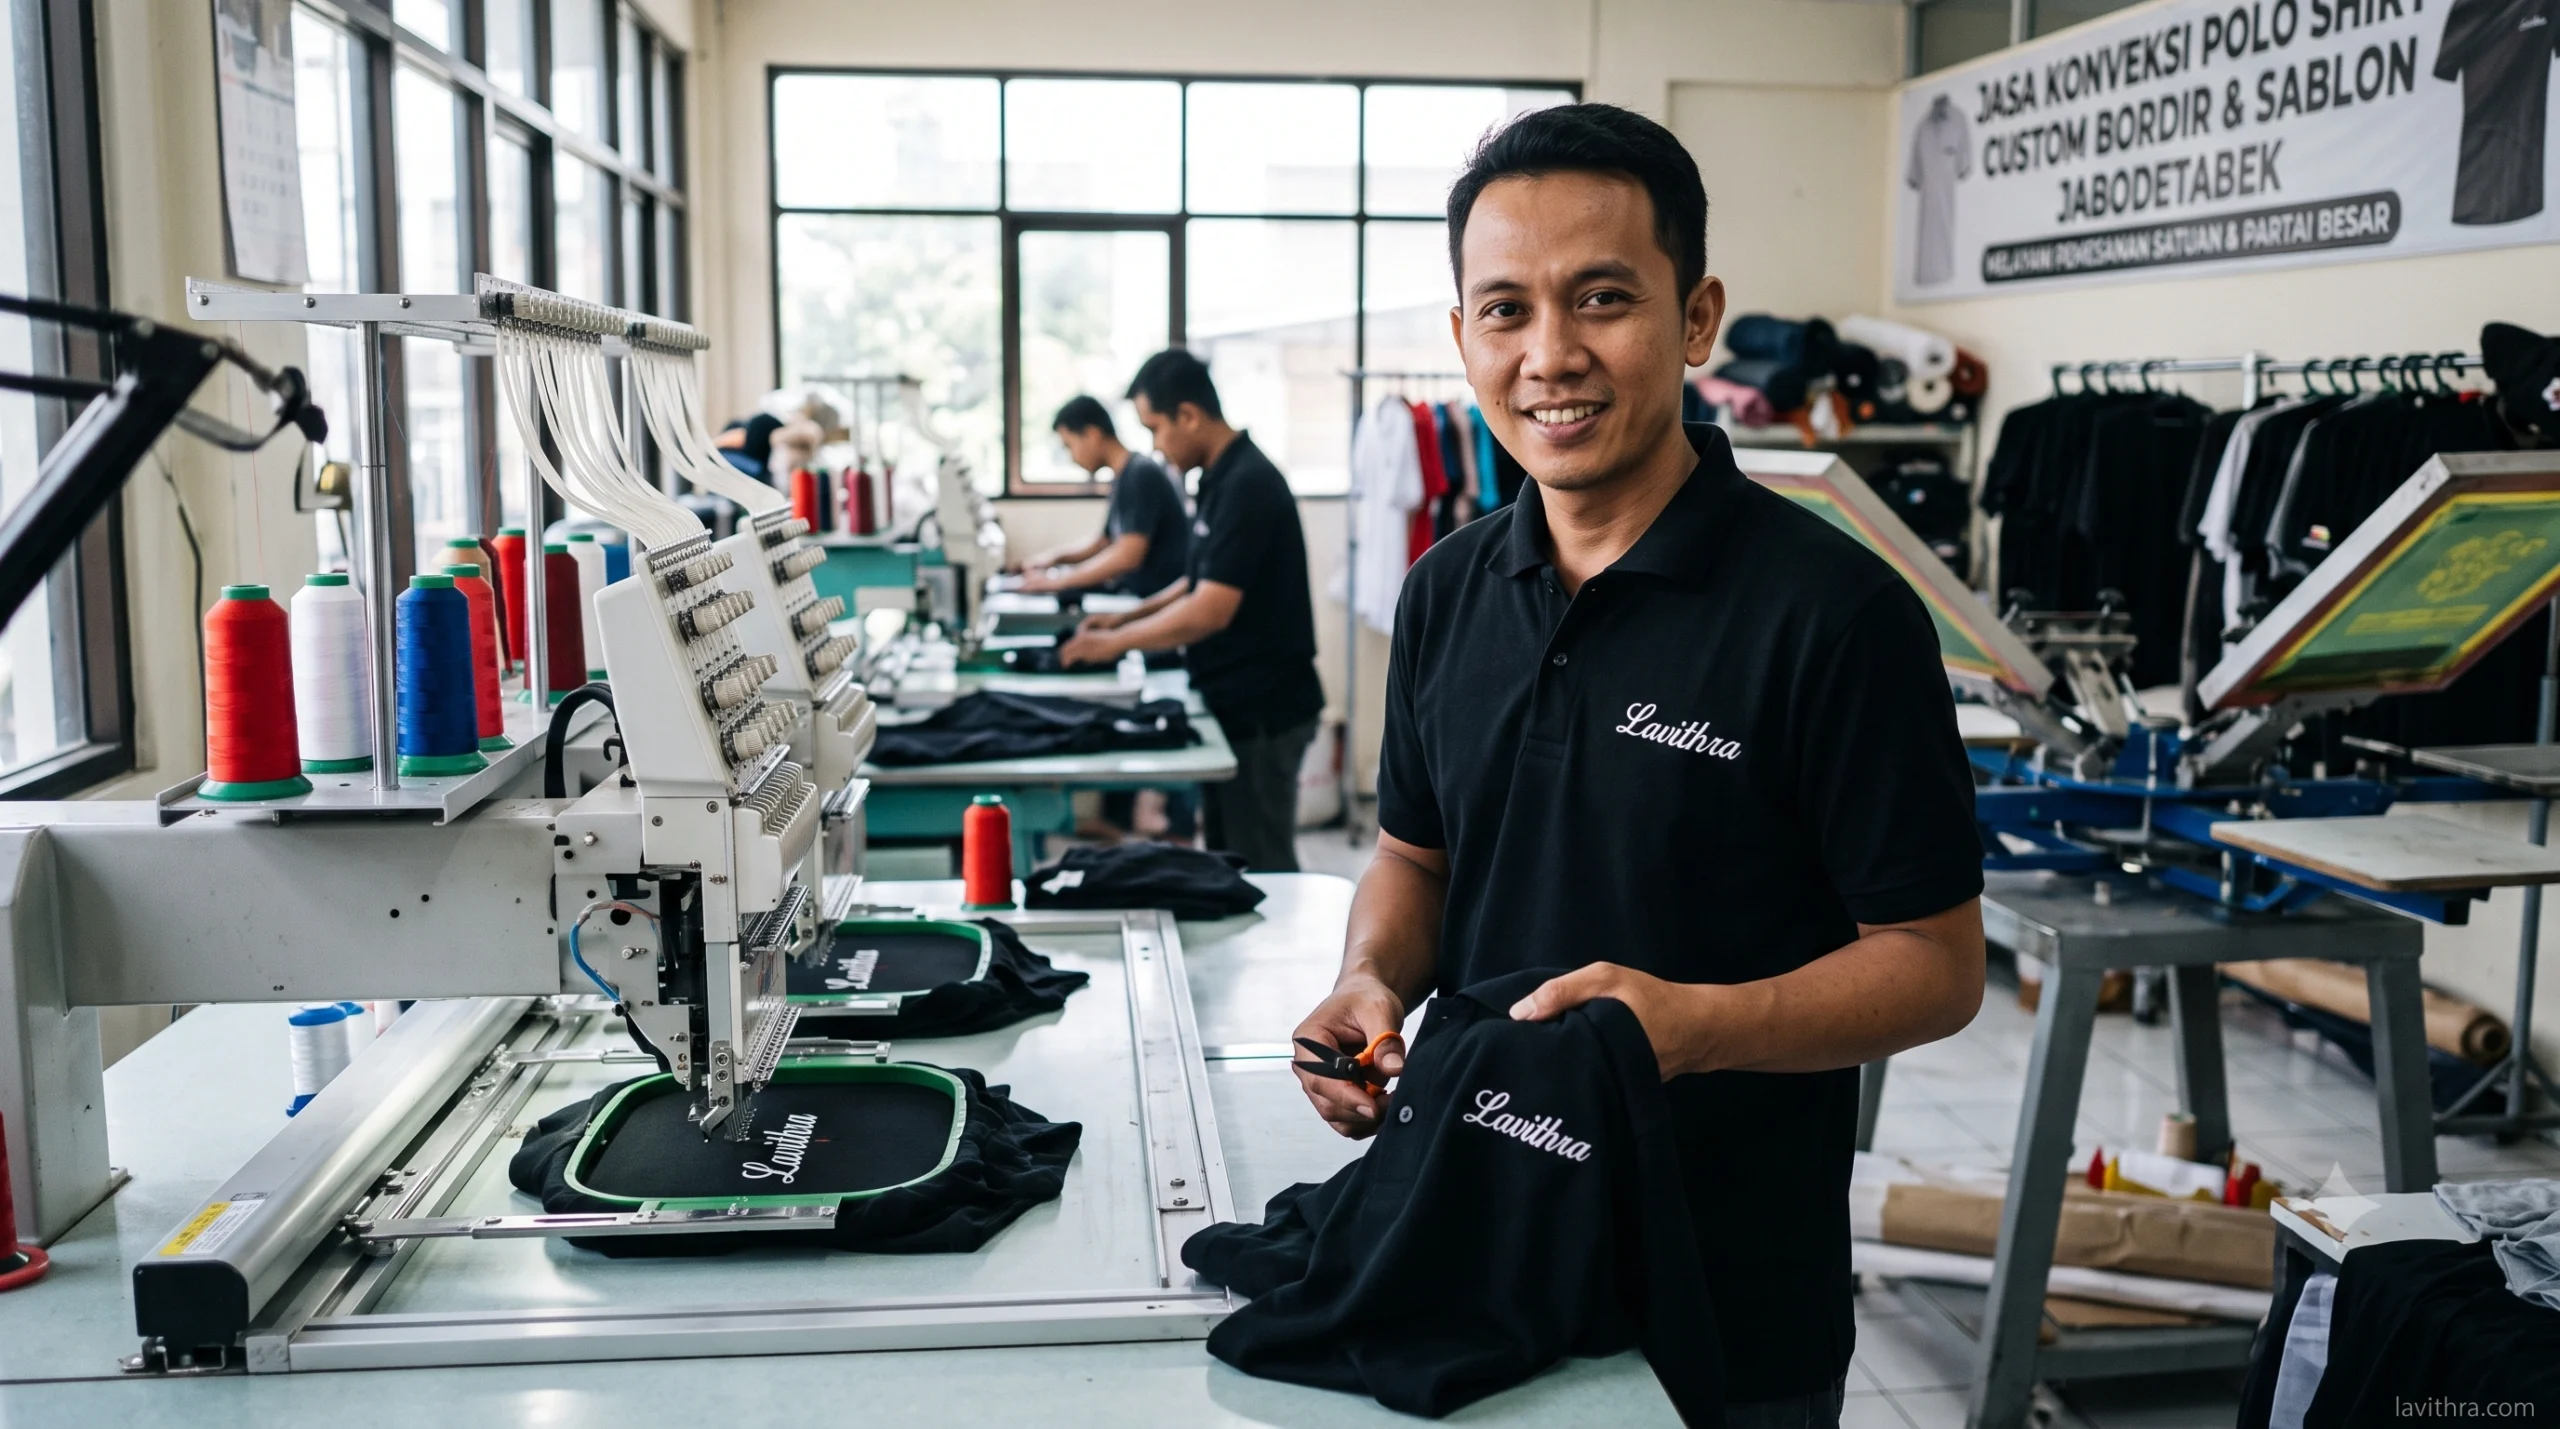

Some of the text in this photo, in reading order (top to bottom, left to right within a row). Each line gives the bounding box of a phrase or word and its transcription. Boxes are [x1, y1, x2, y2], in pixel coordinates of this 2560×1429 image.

[1977, 69, 2036, 125] JASA
[2046, 21, 2192, 105] KONVEKSI
[2203, 0, 2298, 66] POLO
[1984, 36, 2417, 178] CUSTOM BORDIR & SABLON
[2057, 138, 2282, 223] JABODETABEK
[2152, 221, 2223, 260] SATUAN
[2225, 219, 2239, 252] &
[2242, 210, 2314, 250] PARTAI
[2317, 200, 2391, 241] BESAR
[1616, 702, 1742, 760] Lavithra
[742, 1113, 818, 1184] Lavithra
[1463, 1089, 1592, 1162] Lavithra
